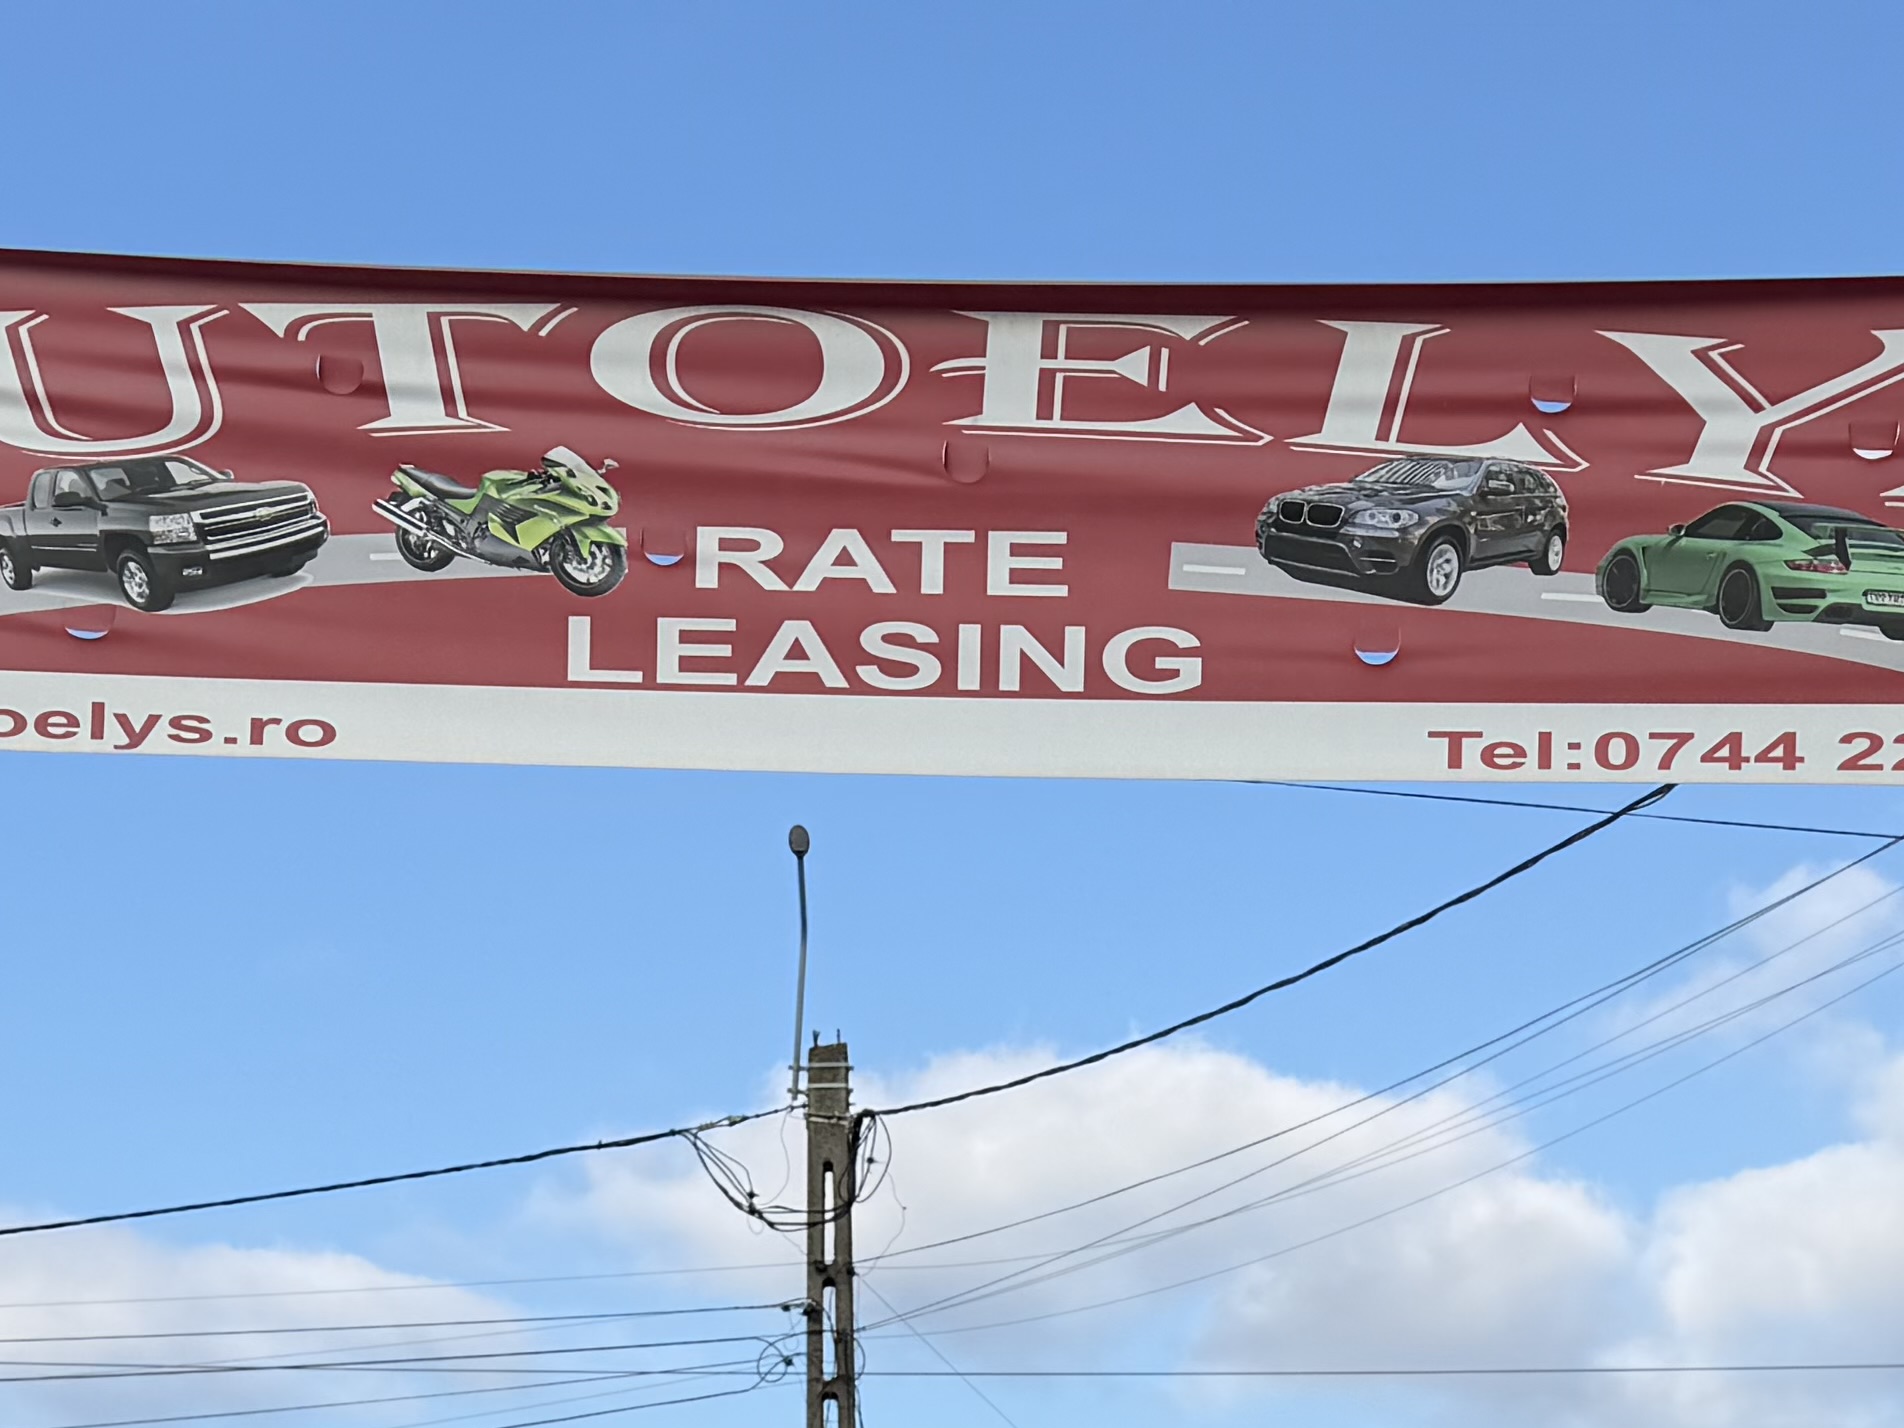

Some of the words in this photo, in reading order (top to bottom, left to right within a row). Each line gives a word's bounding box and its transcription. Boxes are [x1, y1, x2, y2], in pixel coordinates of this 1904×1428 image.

[696, 525, 1070, 598] RATE
[567, 615, 1203, 695] LEASING
[1427, 730, 1805, 772] Tel:0744
